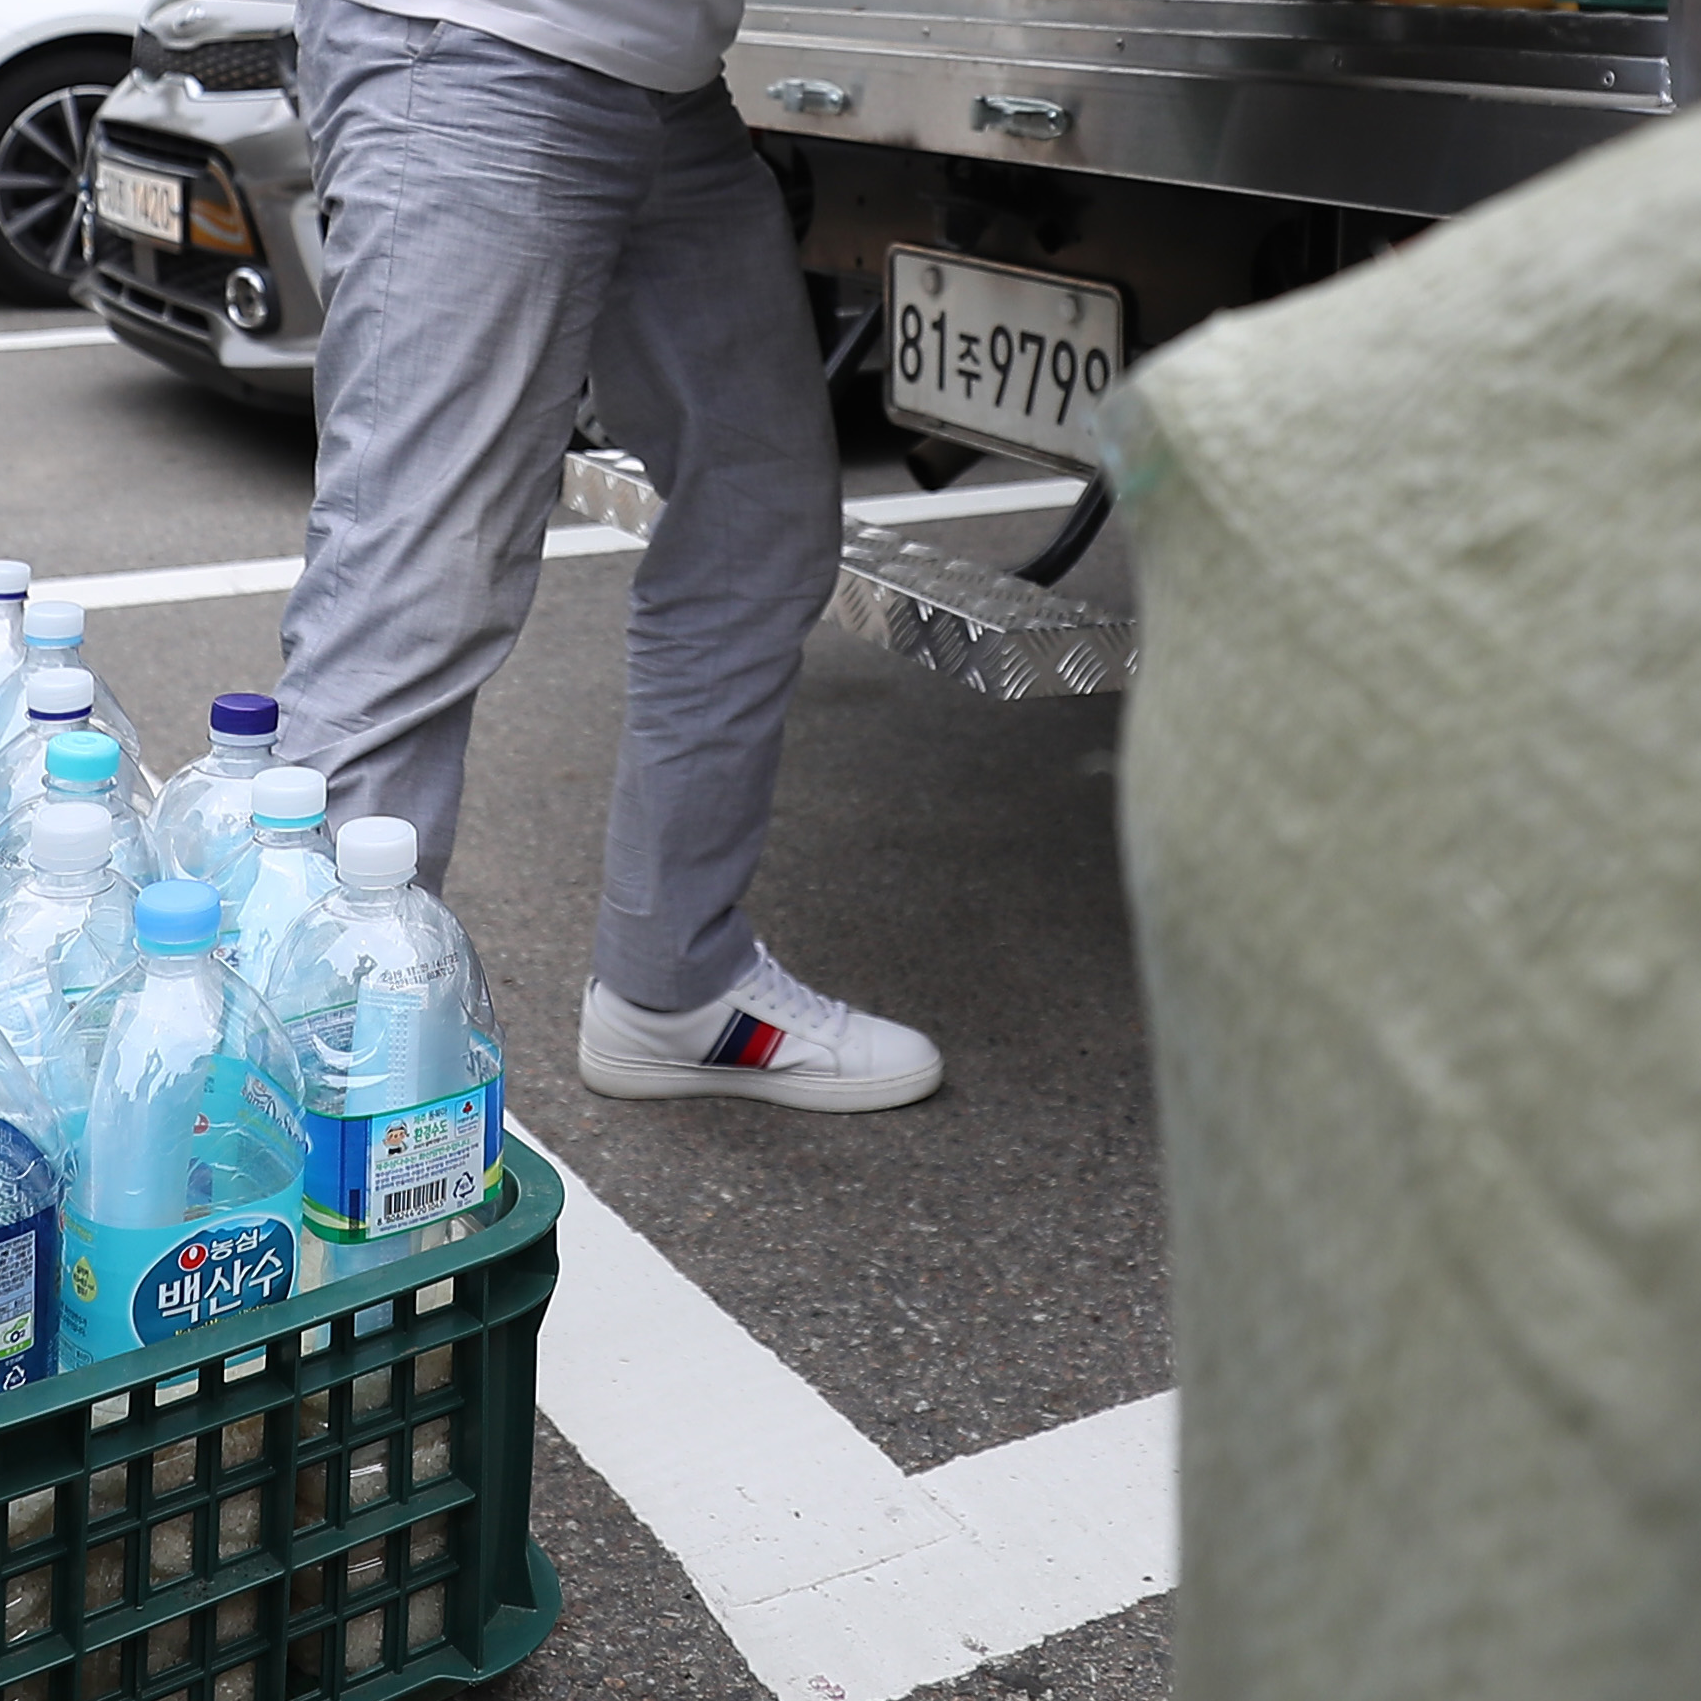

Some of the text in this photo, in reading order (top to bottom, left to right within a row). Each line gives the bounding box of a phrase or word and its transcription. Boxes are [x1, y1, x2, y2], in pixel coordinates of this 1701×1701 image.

[413, 1119, 449, 1143] 환경수도
[210, 1228, 260, 1261] 농심
[158, 1247, 284, 1324] 백산수
